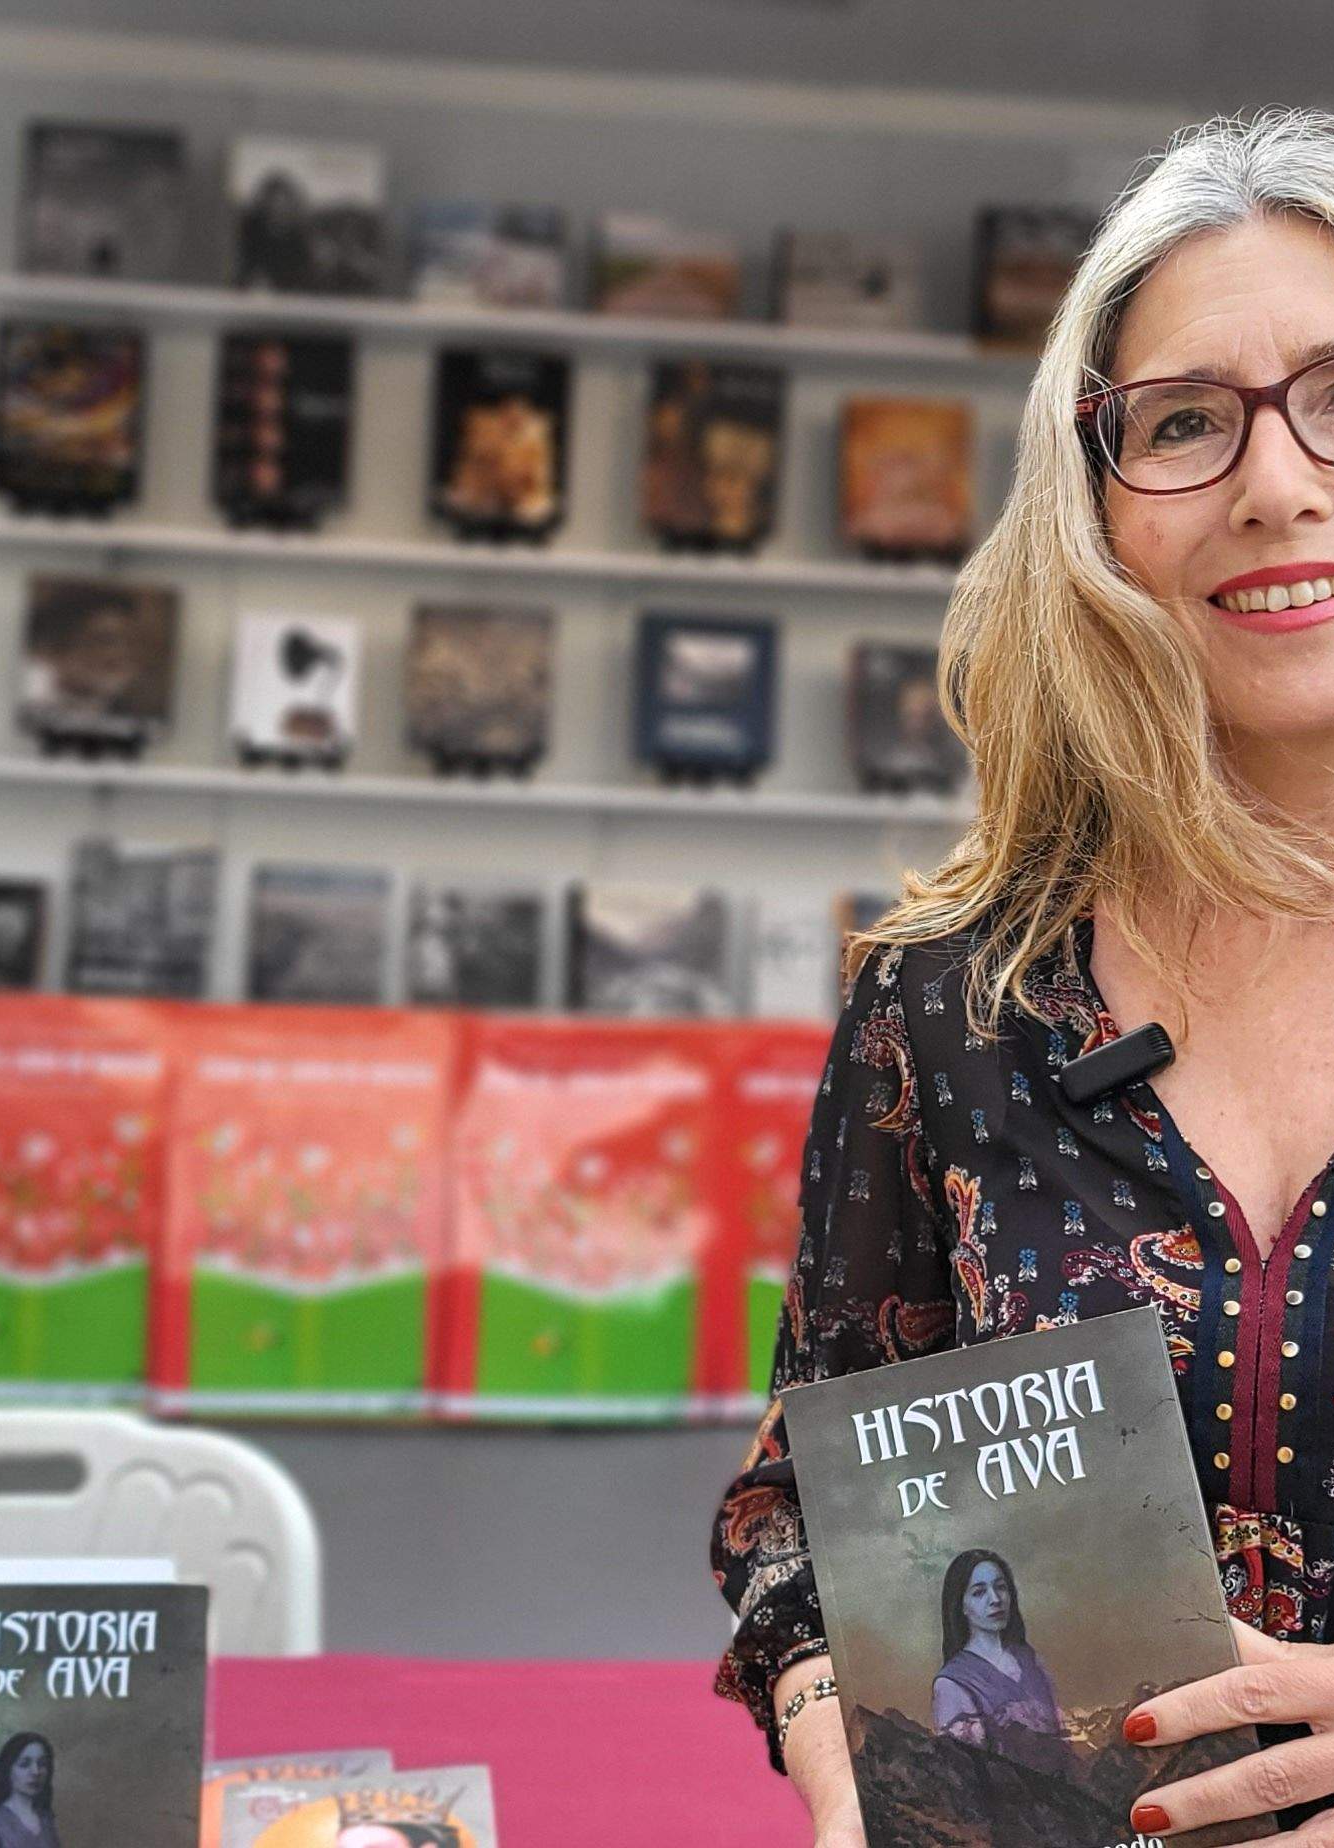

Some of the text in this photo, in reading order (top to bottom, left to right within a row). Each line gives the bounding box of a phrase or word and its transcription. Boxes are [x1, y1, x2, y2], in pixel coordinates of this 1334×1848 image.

[851, 1359, 1105, 1466] HISTORIA
[896, 1425, 1087, 1518] DE AVA
[47, 1656, 131, 1699] AVA
